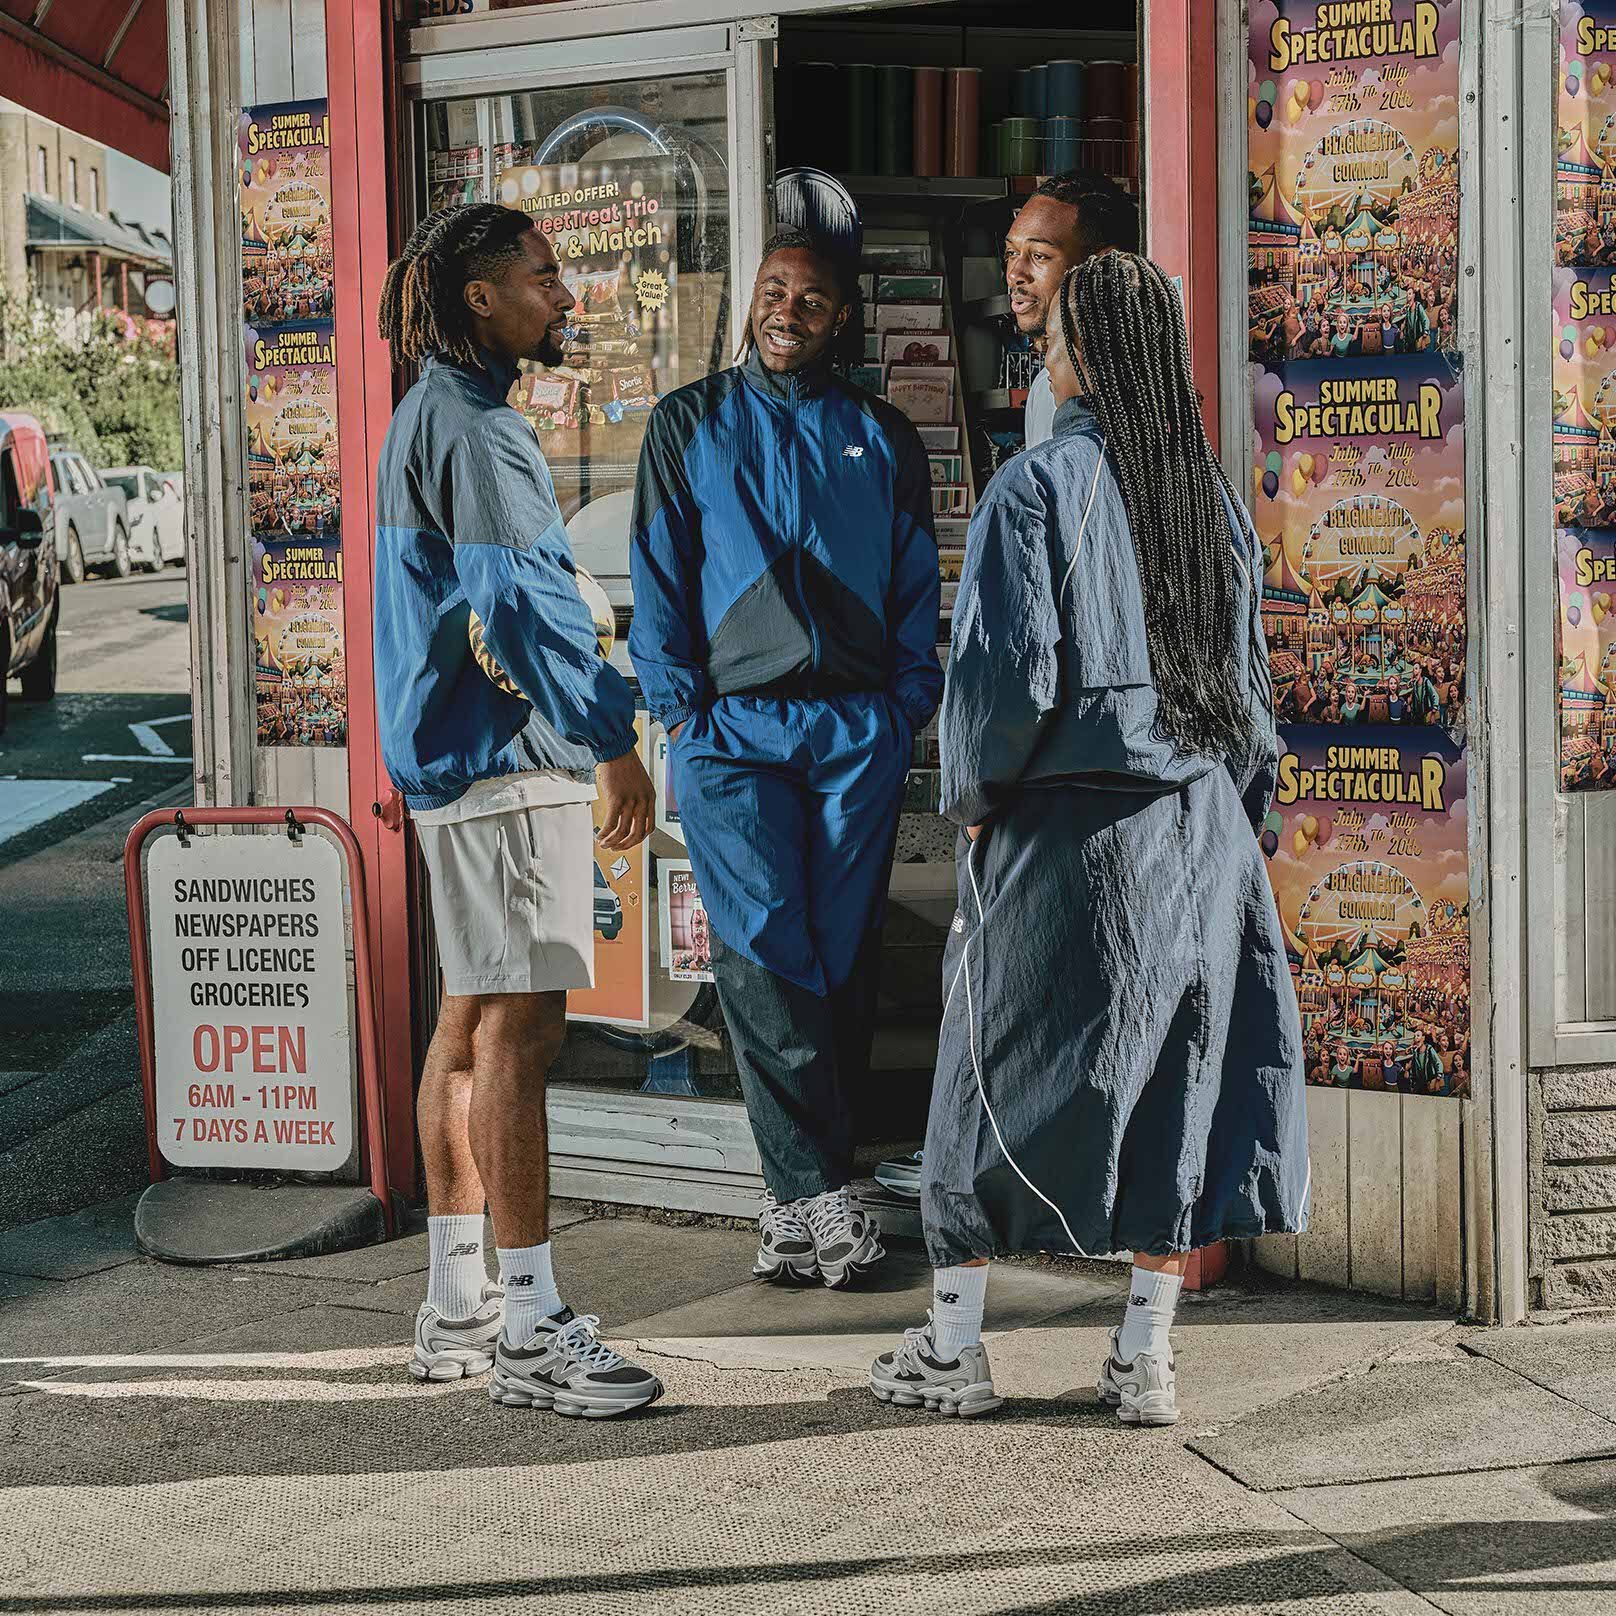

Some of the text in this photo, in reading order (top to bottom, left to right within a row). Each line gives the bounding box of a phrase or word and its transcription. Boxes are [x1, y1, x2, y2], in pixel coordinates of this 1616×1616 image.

[1316, 0, 1392, 29] SUMMER
[1268, 1, 1439, 73] SPECTACULAR
[1378, 62, 1409, 87] July
[271, 112, 311, 130] SUMMER
[521, 182, 620, 213] LIMITED OFFER!
[623, 196, 659, 219] Trio
[567, 235, 584, 259] &
[589, 222, 663, 255] Match
[640, 289, 664, 301] Value!
[641, 280, 662, 291] Great
[278, 331, 318, 347] SUMMER
[912, 383, 946, 394] BIRTHDAY
[1320, 377, 1398, 404] SUMMER
[1275, 384, 1443, 445] SPECTACULAR
[1383, 442, 1415, 465] July
[285, 547, 324, 562] SUMMER
[1327, 745, 1400, 770] SUMMER
[1277, 753, 1446, 812] SPECTACULAR
[1386, 810, 1417, 835] July
[174, 878, 315, 903] SANDWICHES
[672, 882, 697, 894] Berry
[175, 913, 319, 937] NEWSPAPERS
[181, 948, 315, 972] OFF LICENCE
[190, 982, 310, 1008] GROCERIES
[192, 1024, 307, 1074] OPEN
[188, 1084, 235, 1108] 6AM
[258, 1085, 317, 1110] 11PM
[173, 1118, 336, 1146] 7 DAYS A WEEK
